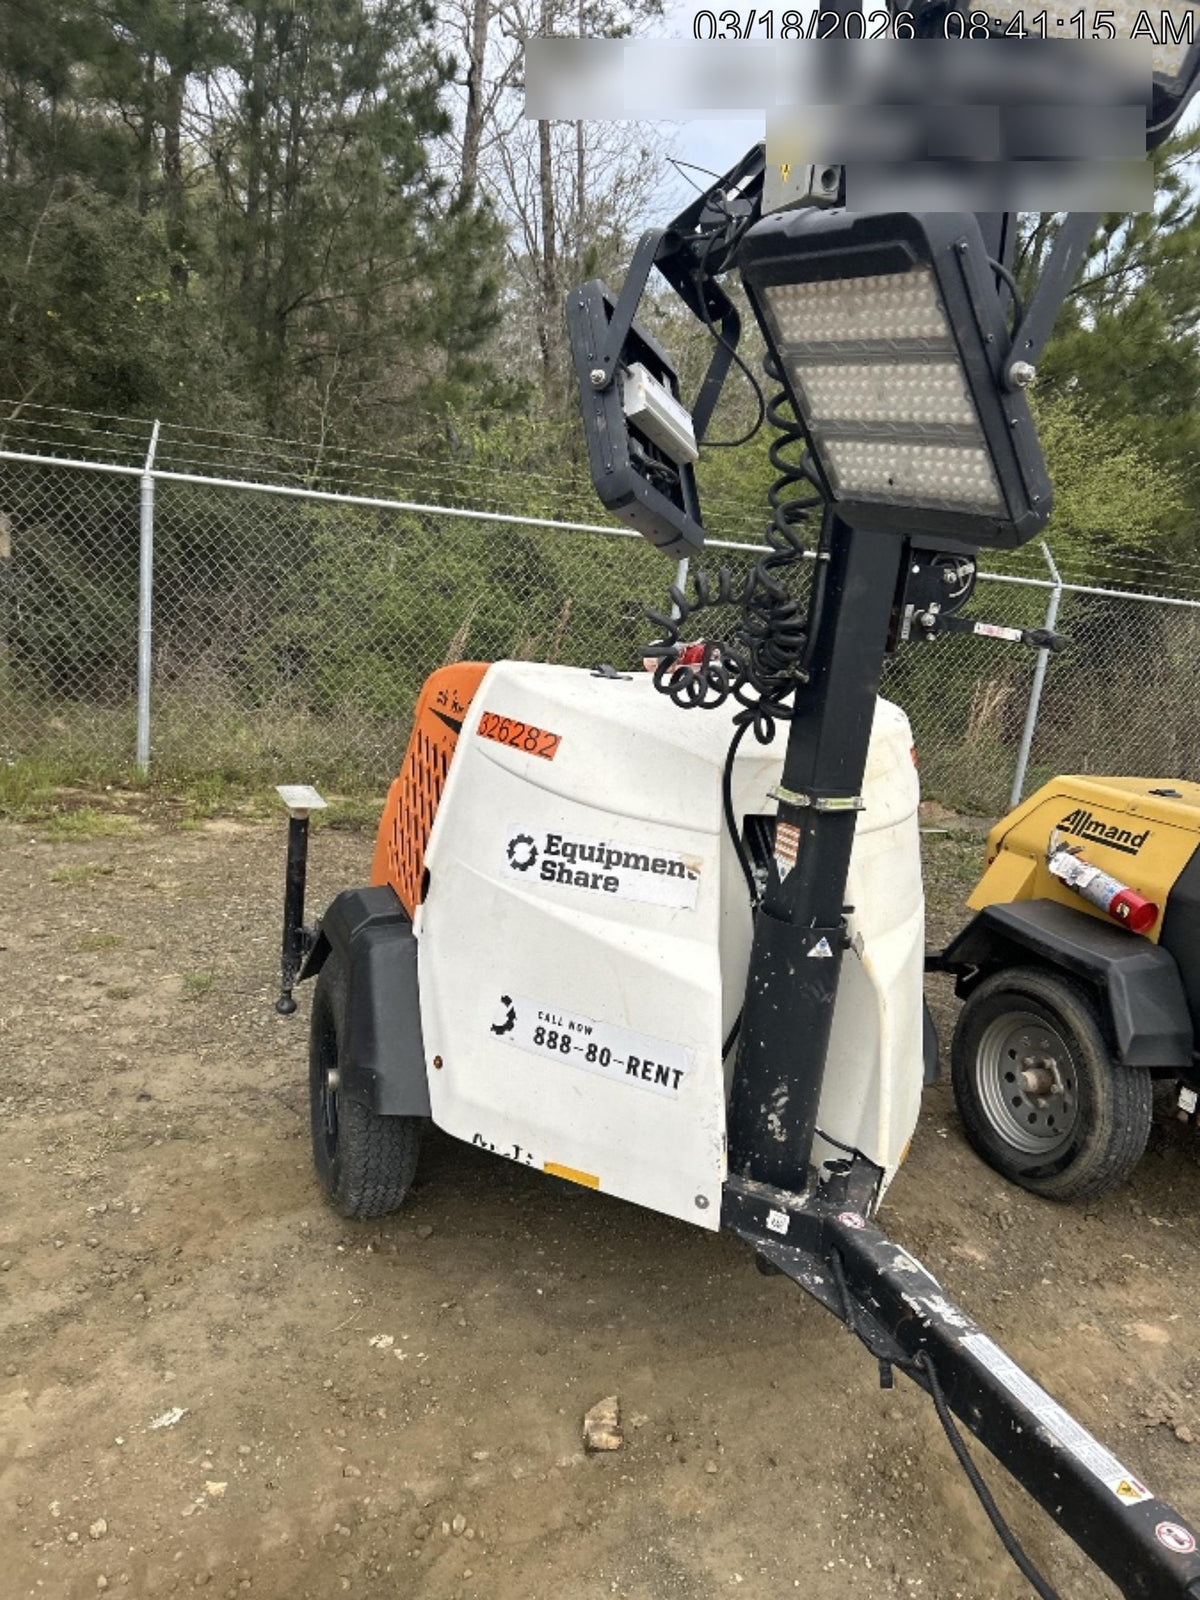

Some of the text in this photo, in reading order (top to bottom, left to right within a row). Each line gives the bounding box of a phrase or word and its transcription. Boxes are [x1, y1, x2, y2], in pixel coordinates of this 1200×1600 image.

[478, 711, 558, 758] 326282
[1060, 808, 1151, 849] Allmand
[539, 858, 620, 893] Share
[537, 1010, 593, 1036] CALL NOW
[532, 1026, 684, 1091] 888-80-RENT
